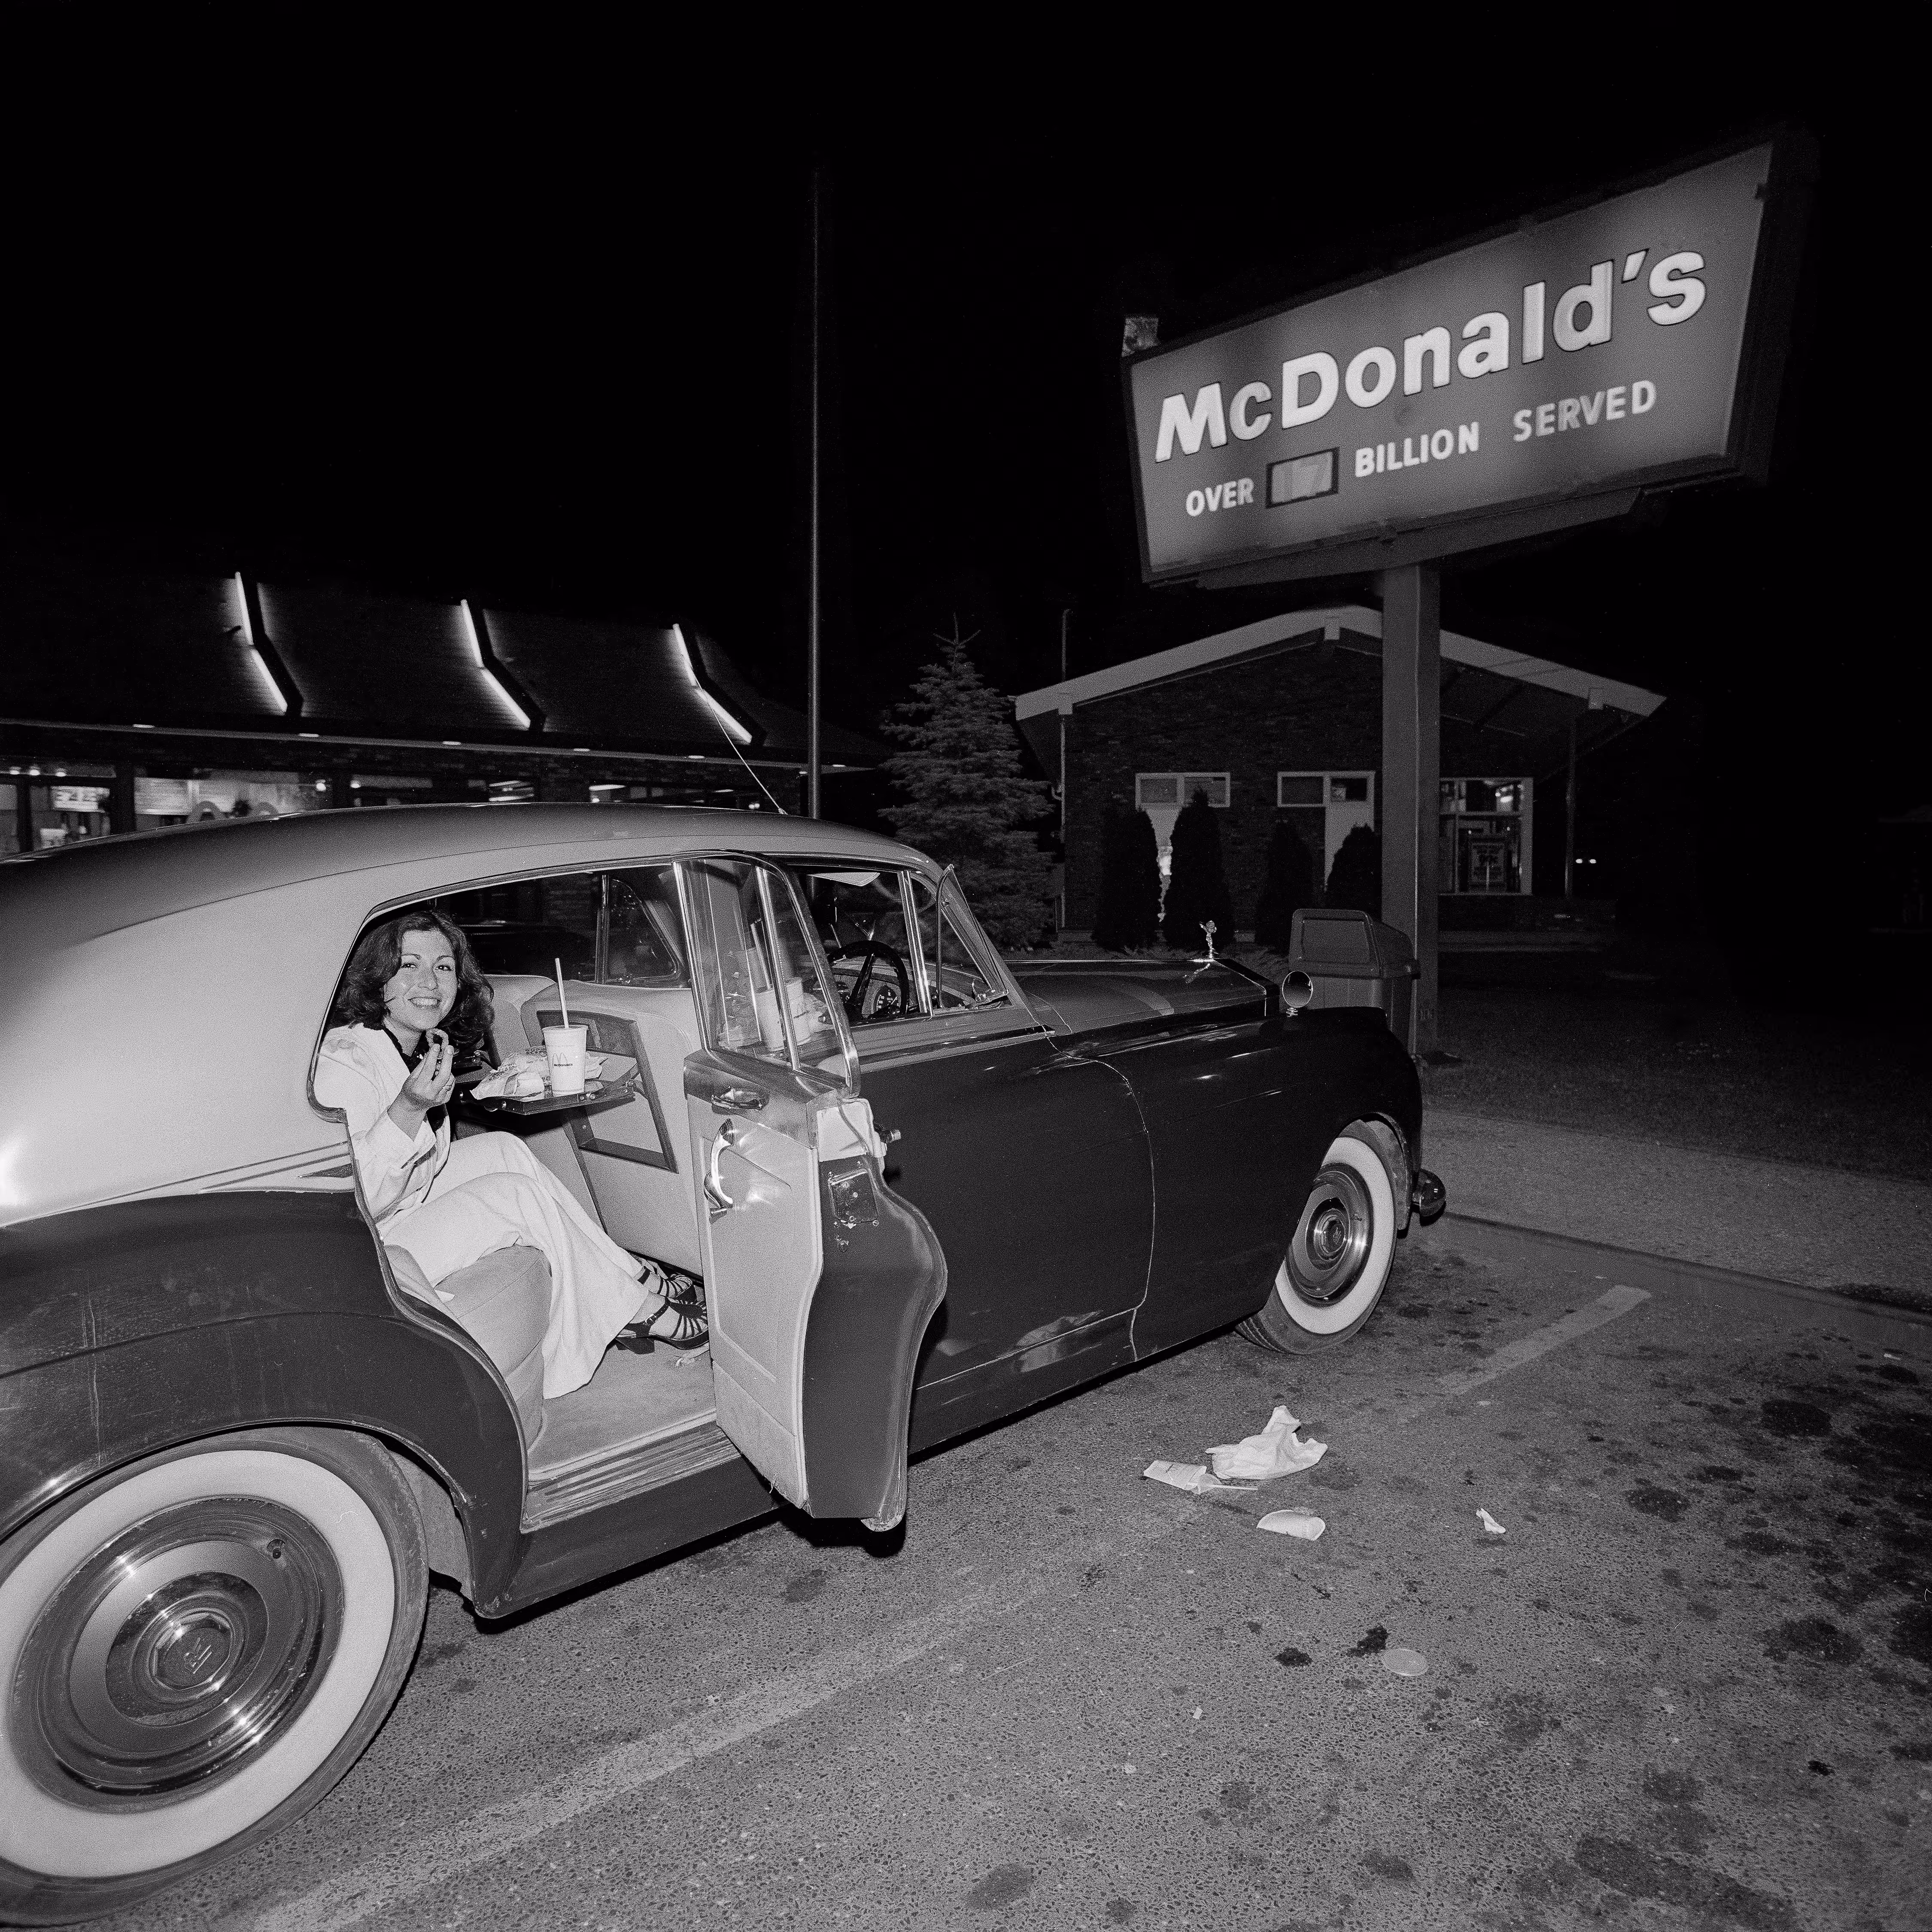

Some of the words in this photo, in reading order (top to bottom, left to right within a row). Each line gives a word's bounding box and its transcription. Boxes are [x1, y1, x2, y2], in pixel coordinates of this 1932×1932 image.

[1155, 248, 1707, 463] McDonald's
[1185, 477, 1255, 516] OVER
[1355, 421, 1479, 477] BILLION
[1513, 380, 1657, 442] SERVED
